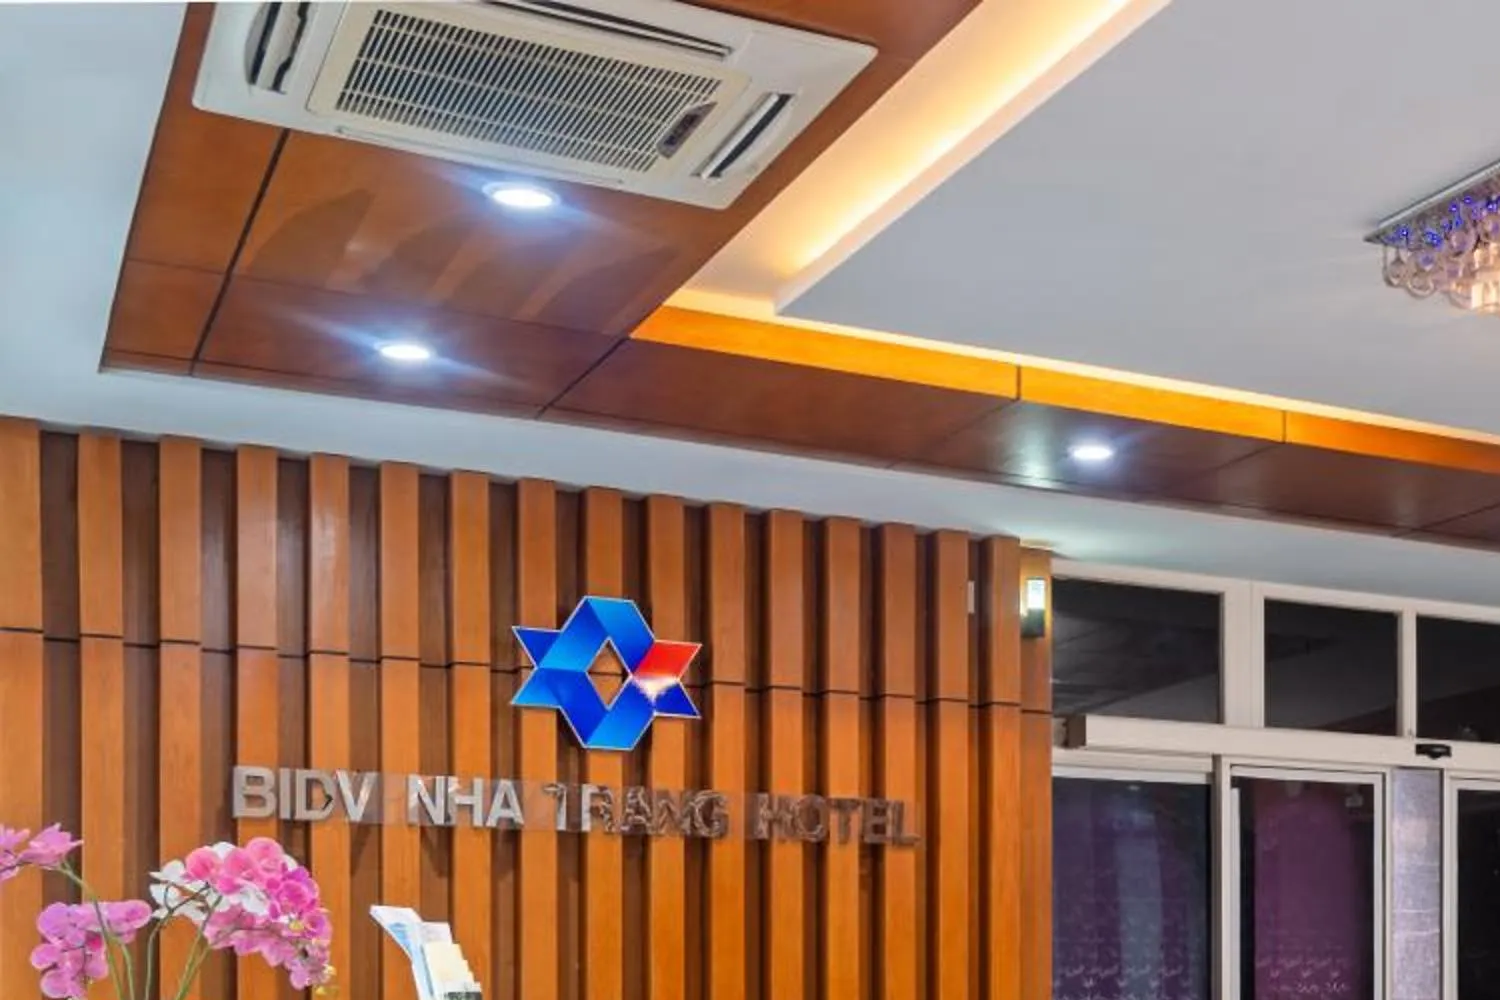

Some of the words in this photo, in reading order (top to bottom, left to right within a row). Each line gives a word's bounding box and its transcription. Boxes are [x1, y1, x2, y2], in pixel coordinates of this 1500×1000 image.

[232, 765, 378, 822] BIDV
[406, 774, 525, 828] NHA
[543, 782, 729, 839] TRANG
[755, 792, 921, 847] HOTEL
